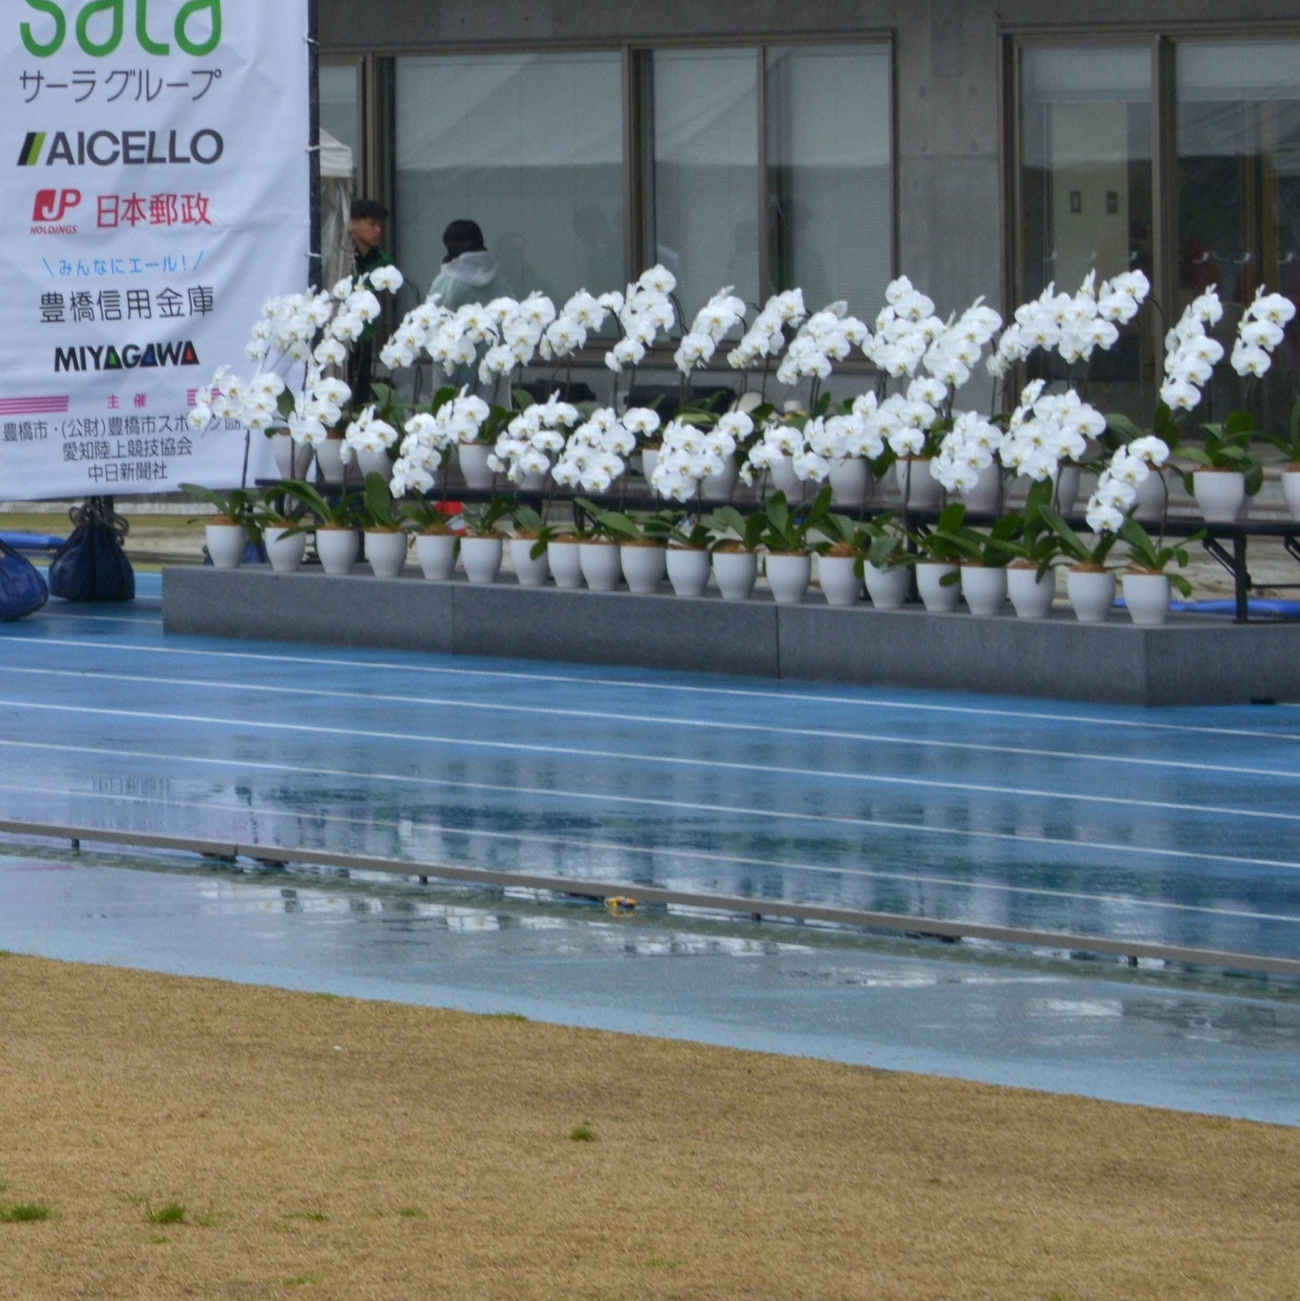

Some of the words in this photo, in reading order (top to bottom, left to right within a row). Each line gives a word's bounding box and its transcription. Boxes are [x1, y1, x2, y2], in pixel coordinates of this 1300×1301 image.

[18, 68, 223, 104] サーラグループ
[45, 128, 225, 167] AICELLO
[32, 187, 82, 223] JP
[96, 193, 212, 228] 日本郵政
[29, 225, 78, 235] HOLDINGS
[38, 286, 215, 326] 豊橋信用金庫
[54, 339, 201, 373] MIYAGAWA
[107, 393, 147, 410] 主催
[62, 436, 193, 462] 愛知陸上競技協会
[88, 461, 169, 483] 中日新聞社
